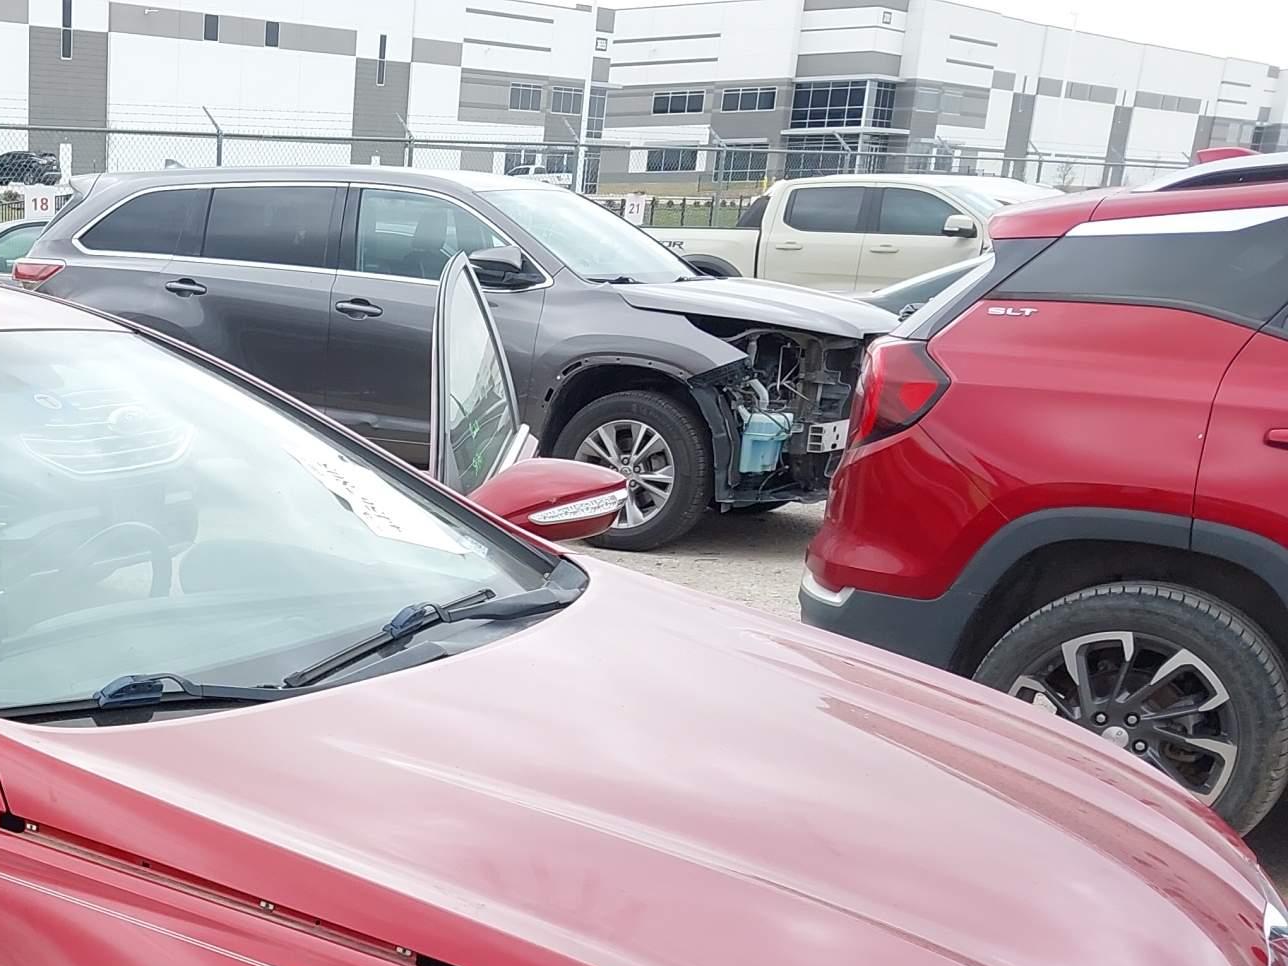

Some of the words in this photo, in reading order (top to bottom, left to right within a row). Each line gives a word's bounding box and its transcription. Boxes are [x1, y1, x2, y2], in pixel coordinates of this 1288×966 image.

[32, 197, 49, 211] 18
[628, 203, 640, 214] 21
[987, 307, 1038, 316] SLT
